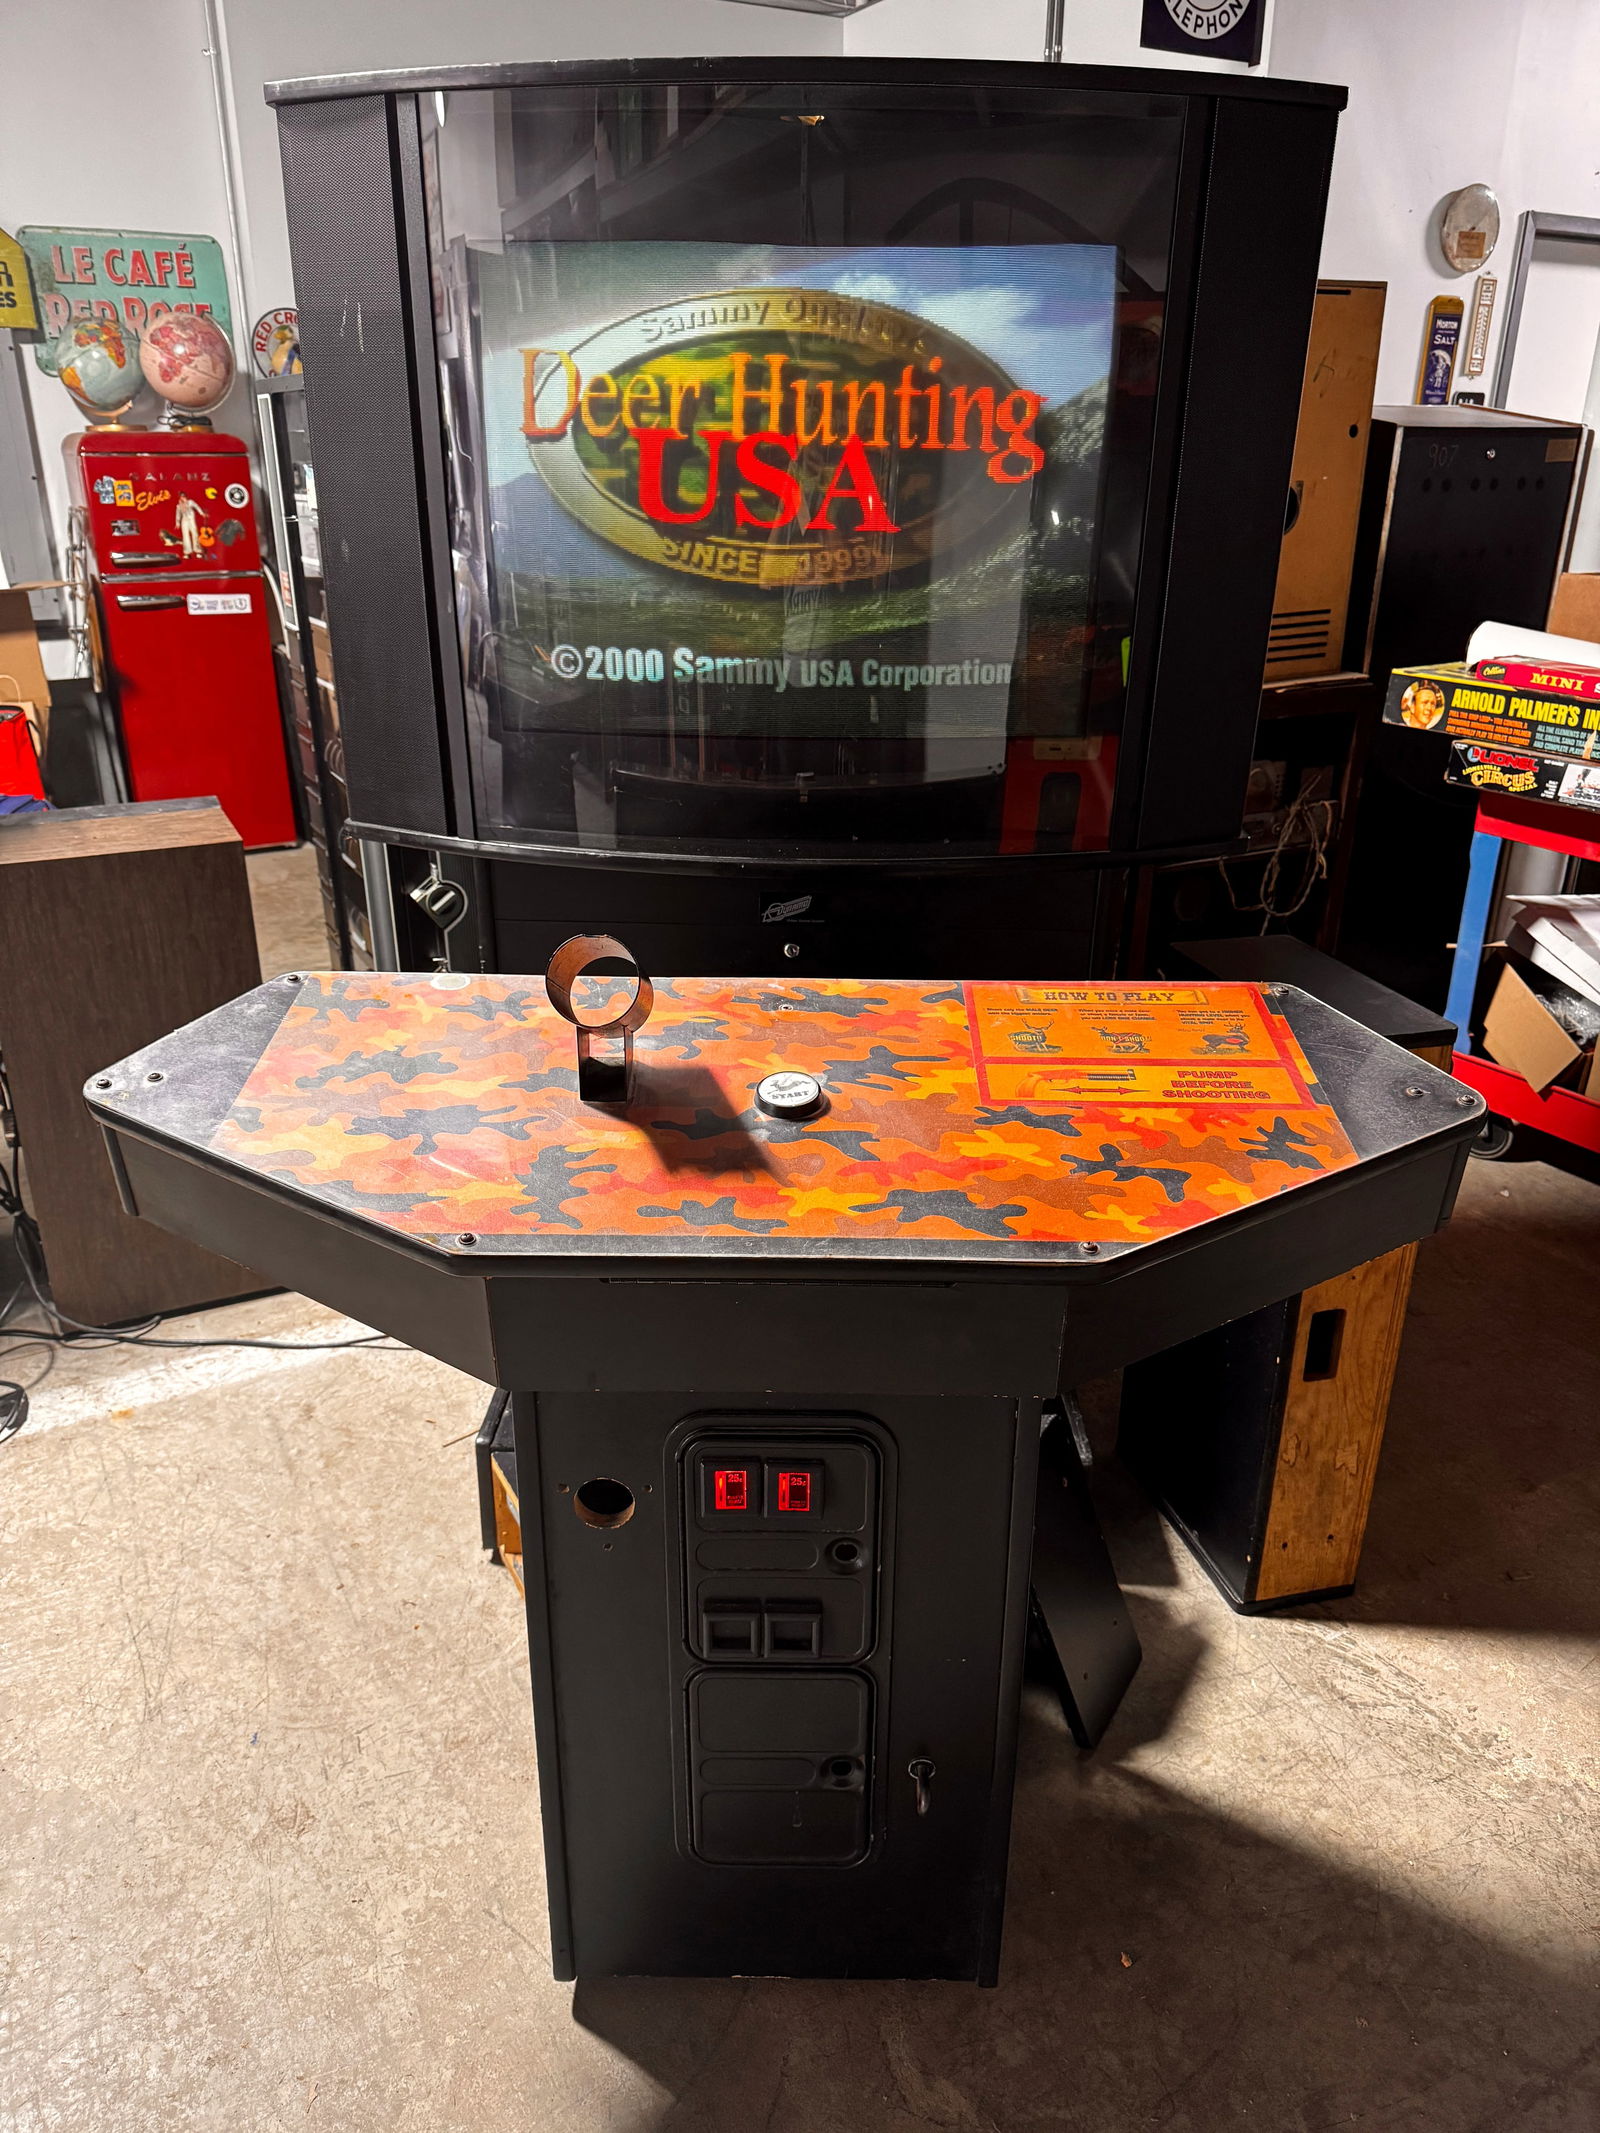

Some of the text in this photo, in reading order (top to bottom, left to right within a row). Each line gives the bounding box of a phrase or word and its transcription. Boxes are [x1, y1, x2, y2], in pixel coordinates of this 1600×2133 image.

[51, 245, 96, 285] LE
[103, 242, 196, 288] CAFÉ
[255, 321, 273, 352] RED
[1433, 334, 1456, 345] SALT
[519, 347, 1049, 484] Deer Hunting
[631, 428, 901, 534] USA
[135, 489, 171, 511] Elvis
[662, 537, 760, 574] SINCE
[673, 647, 791, 693] Sammy
[800, 659, 854, 687] USA
[862, 658, 1013, 691] Corporation
[1530, 673, 1584, 691] MINI
[1451, 689, 1506, 714] ARNOLD
[1508, 697, 1580, 727] PALMER'S
[1480, 748, 1540, 773] LIONEL
[1471, 770, 1535, 787] CIRCUS
[1508, 783, 1538, 792] SPECIAL
[1043, 991, 1175, 1002] HOW TO PLAY
[1171, 1080, 1254, 1089] BEFORE
[1177, 1071, 1238, 1079] PUMP
[771, 1091, 809, 1100] START
[1162, 1089, 1271, 1099] SHOOTING
